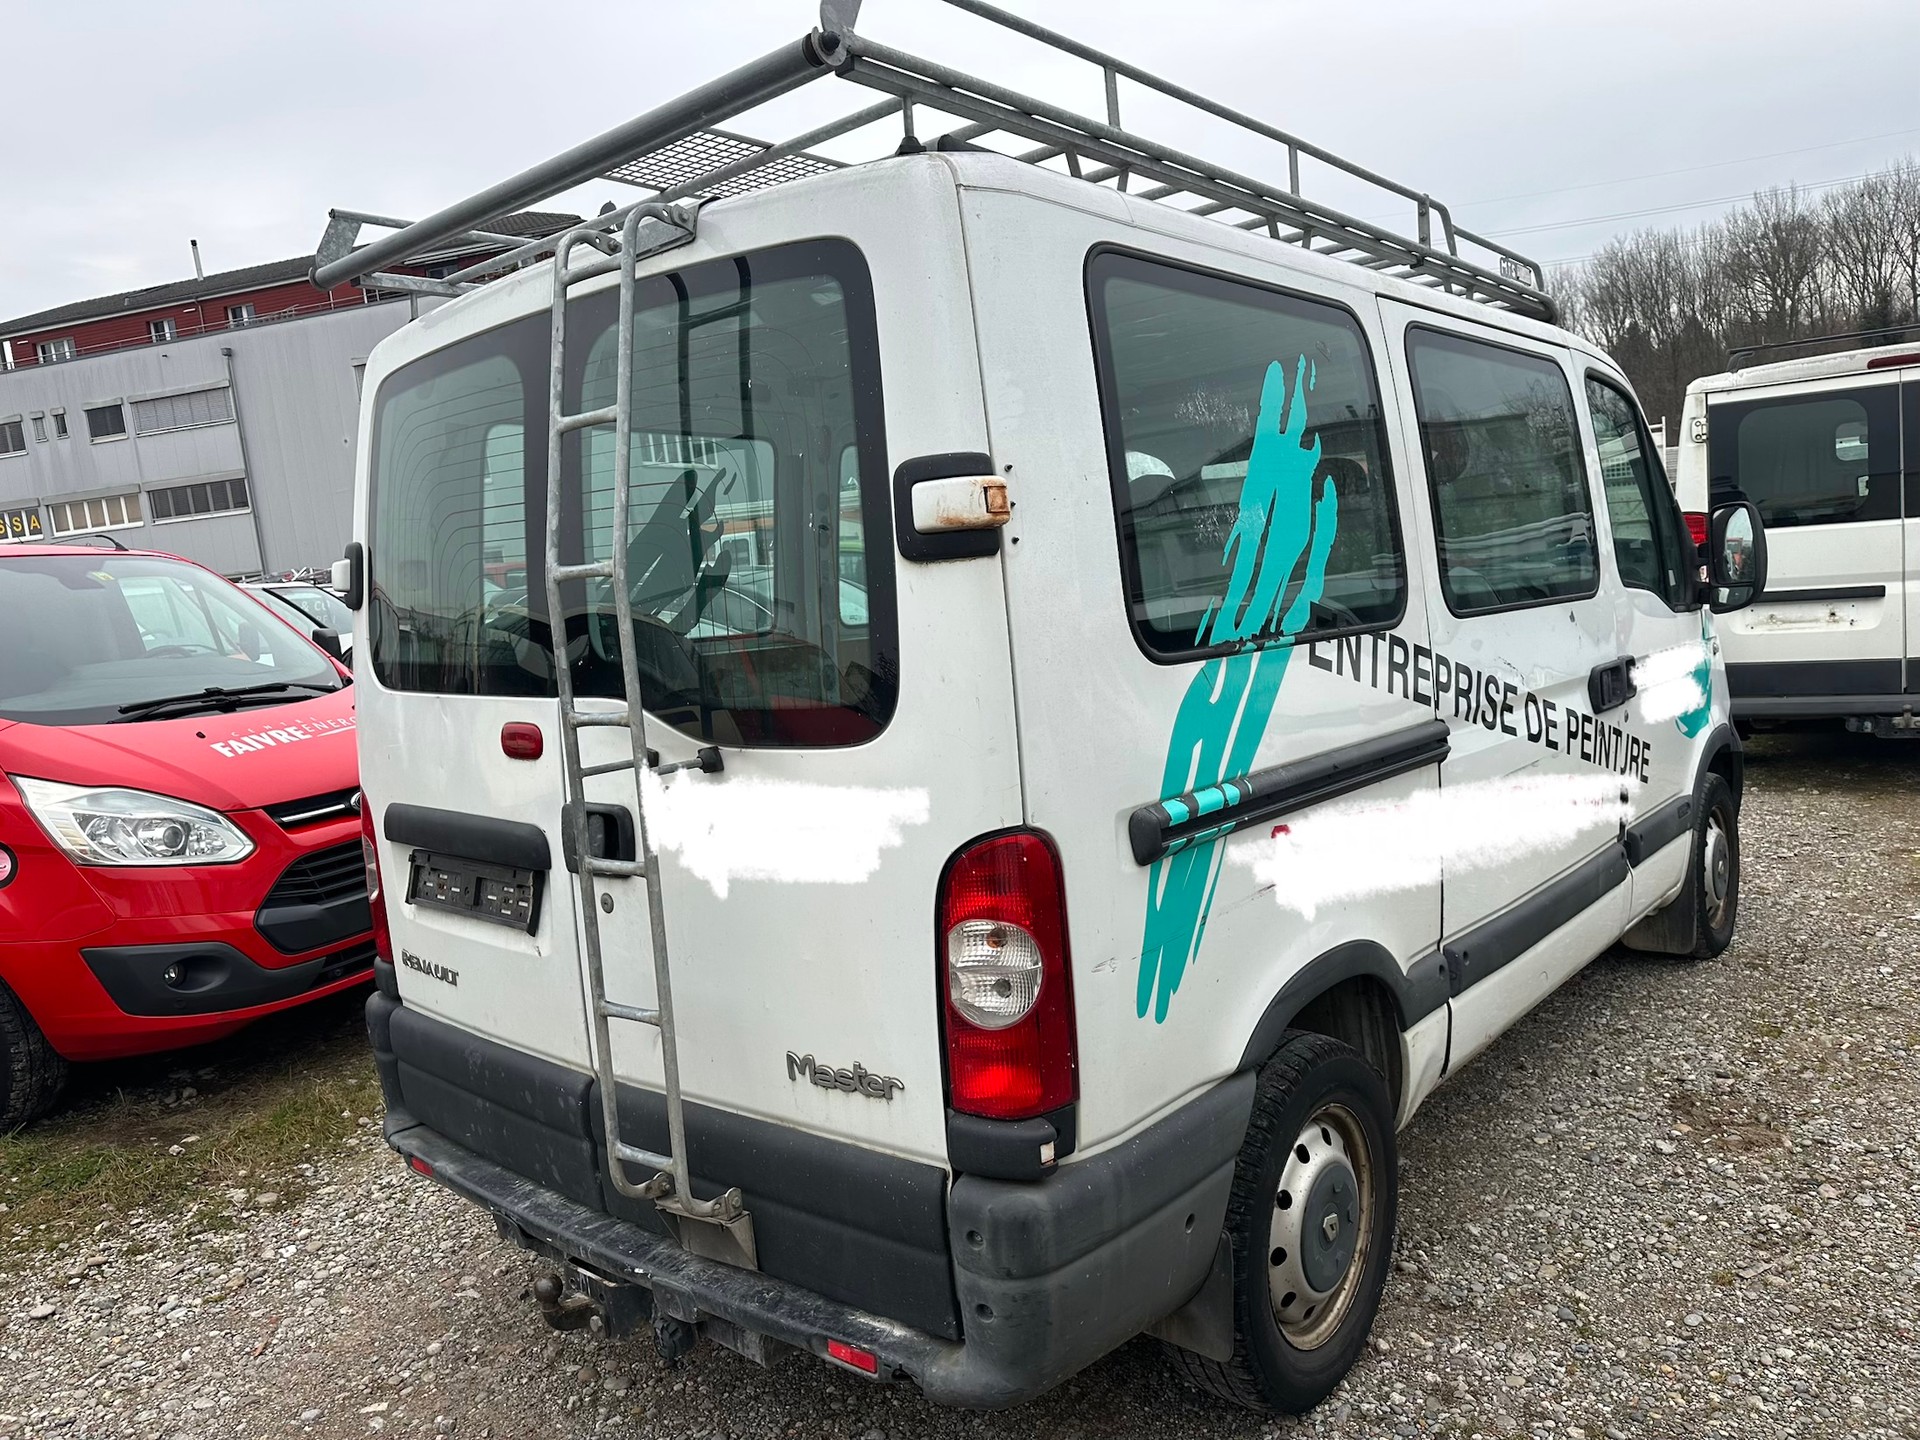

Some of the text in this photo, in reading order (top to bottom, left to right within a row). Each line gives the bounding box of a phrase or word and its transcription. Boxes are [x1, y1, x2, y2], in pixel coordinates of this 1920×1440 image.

[1309, 600, 1518, 737] ENTREPRISE
[1525, 691, 1559, 751] DE
[210, 726, 312, 758] FAIVRE
[401, 949, 459, 987] RENAULT
[786, 1050, 905, 1100] Master
